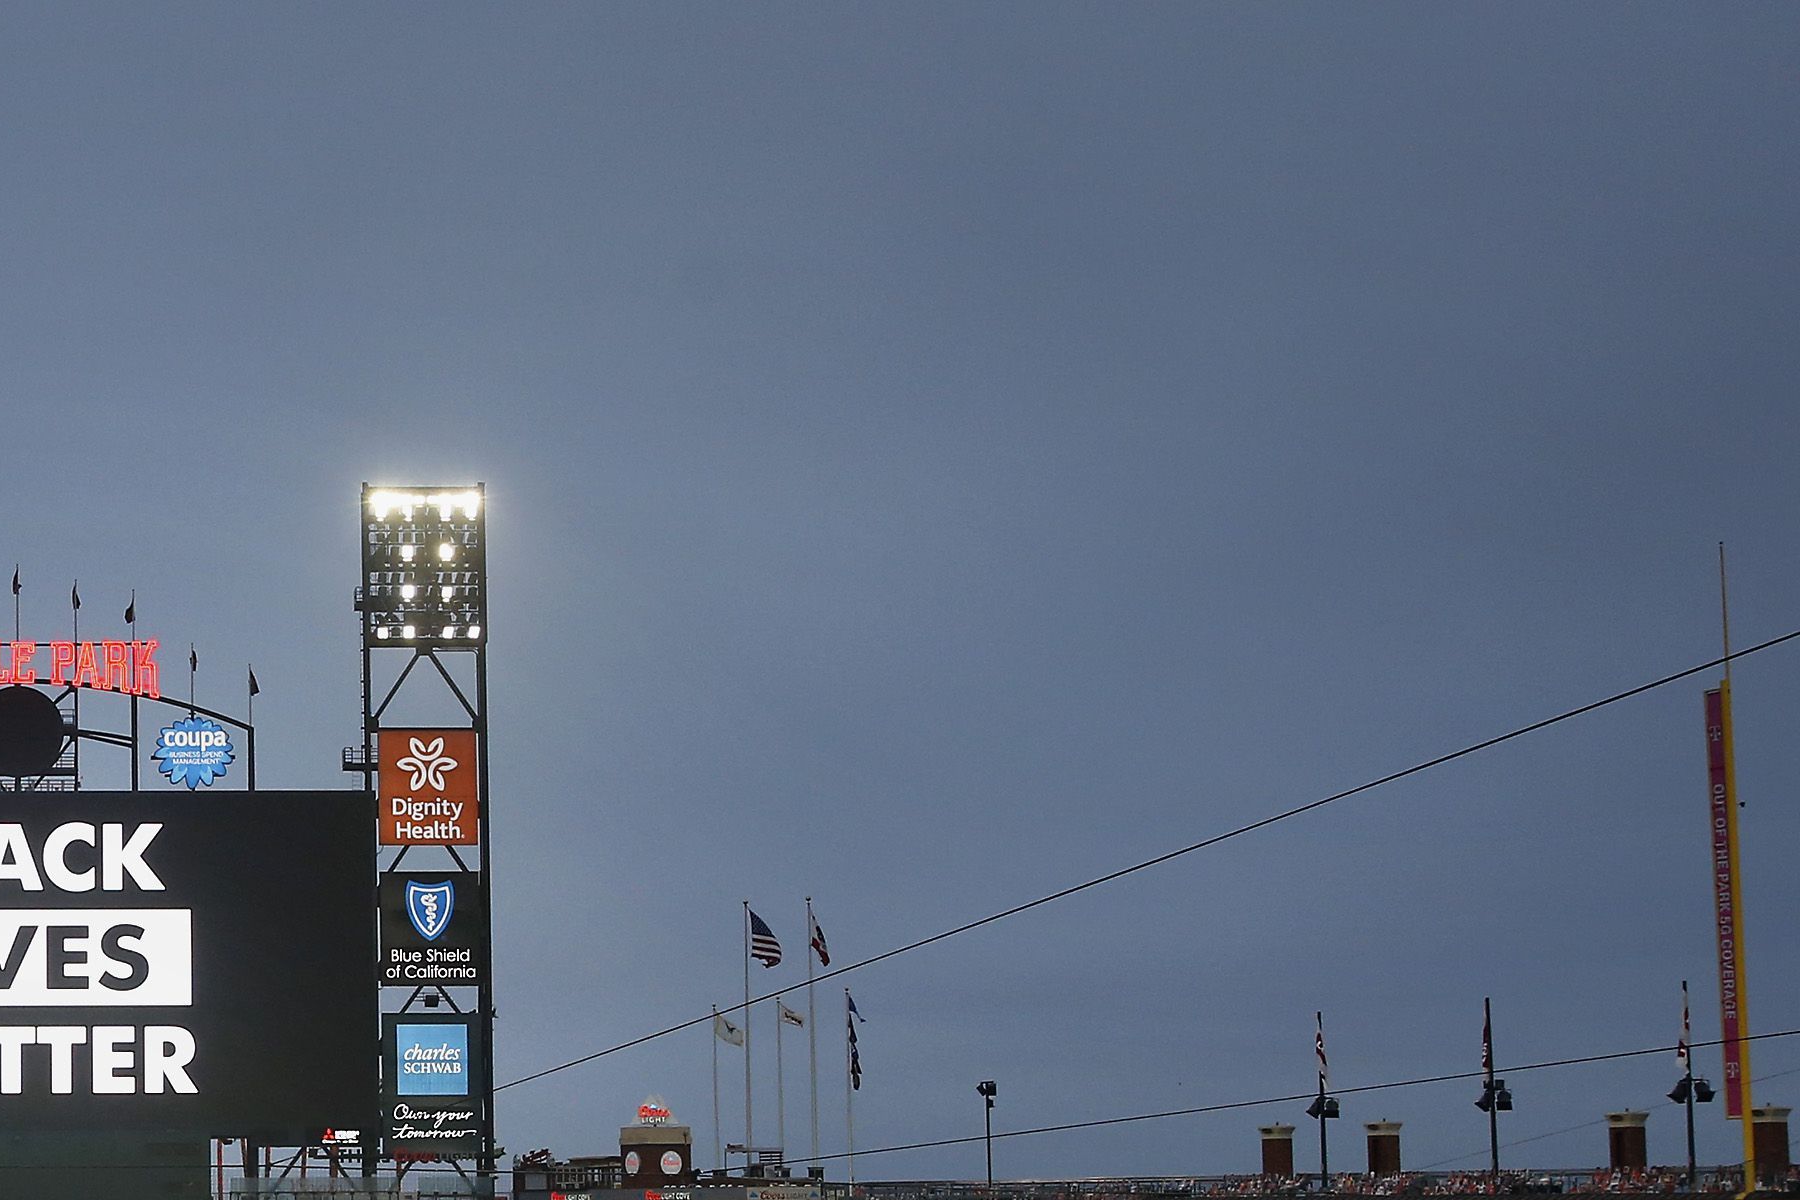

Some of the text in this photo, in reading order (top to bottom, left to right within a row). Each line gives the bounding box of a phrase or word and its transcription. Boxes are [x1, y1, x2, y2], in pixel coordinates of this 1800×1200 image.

[51, 640, 161, 698] PARK
[164, 729, 227, 752] coupa
[391, 798, 464, 820] Dignity
[1713, 784, 1726, 814] OUT
[395, 820, 462, 839] Health
[1715, 818, 1728, 838] OF
[1715, 841, 1730, 869] THE
[1717, 873, 1732, 911] PARK
[391, 949, 470, 963] Blue Shield
[386, 964, 477, 979] of California
[1720, 939, 1736, 1020] COVERAGE
[403, 1043, 461, 1061] charles
[403, 1062, 462, 1075] SCHWAB
[393, 1104, 474, 1129] Own your
[392, 1124, 477, 1140] tomorrow
[677, 1192, 692, 1200] COVE
[760, 1191, 786, 1200] Coors
